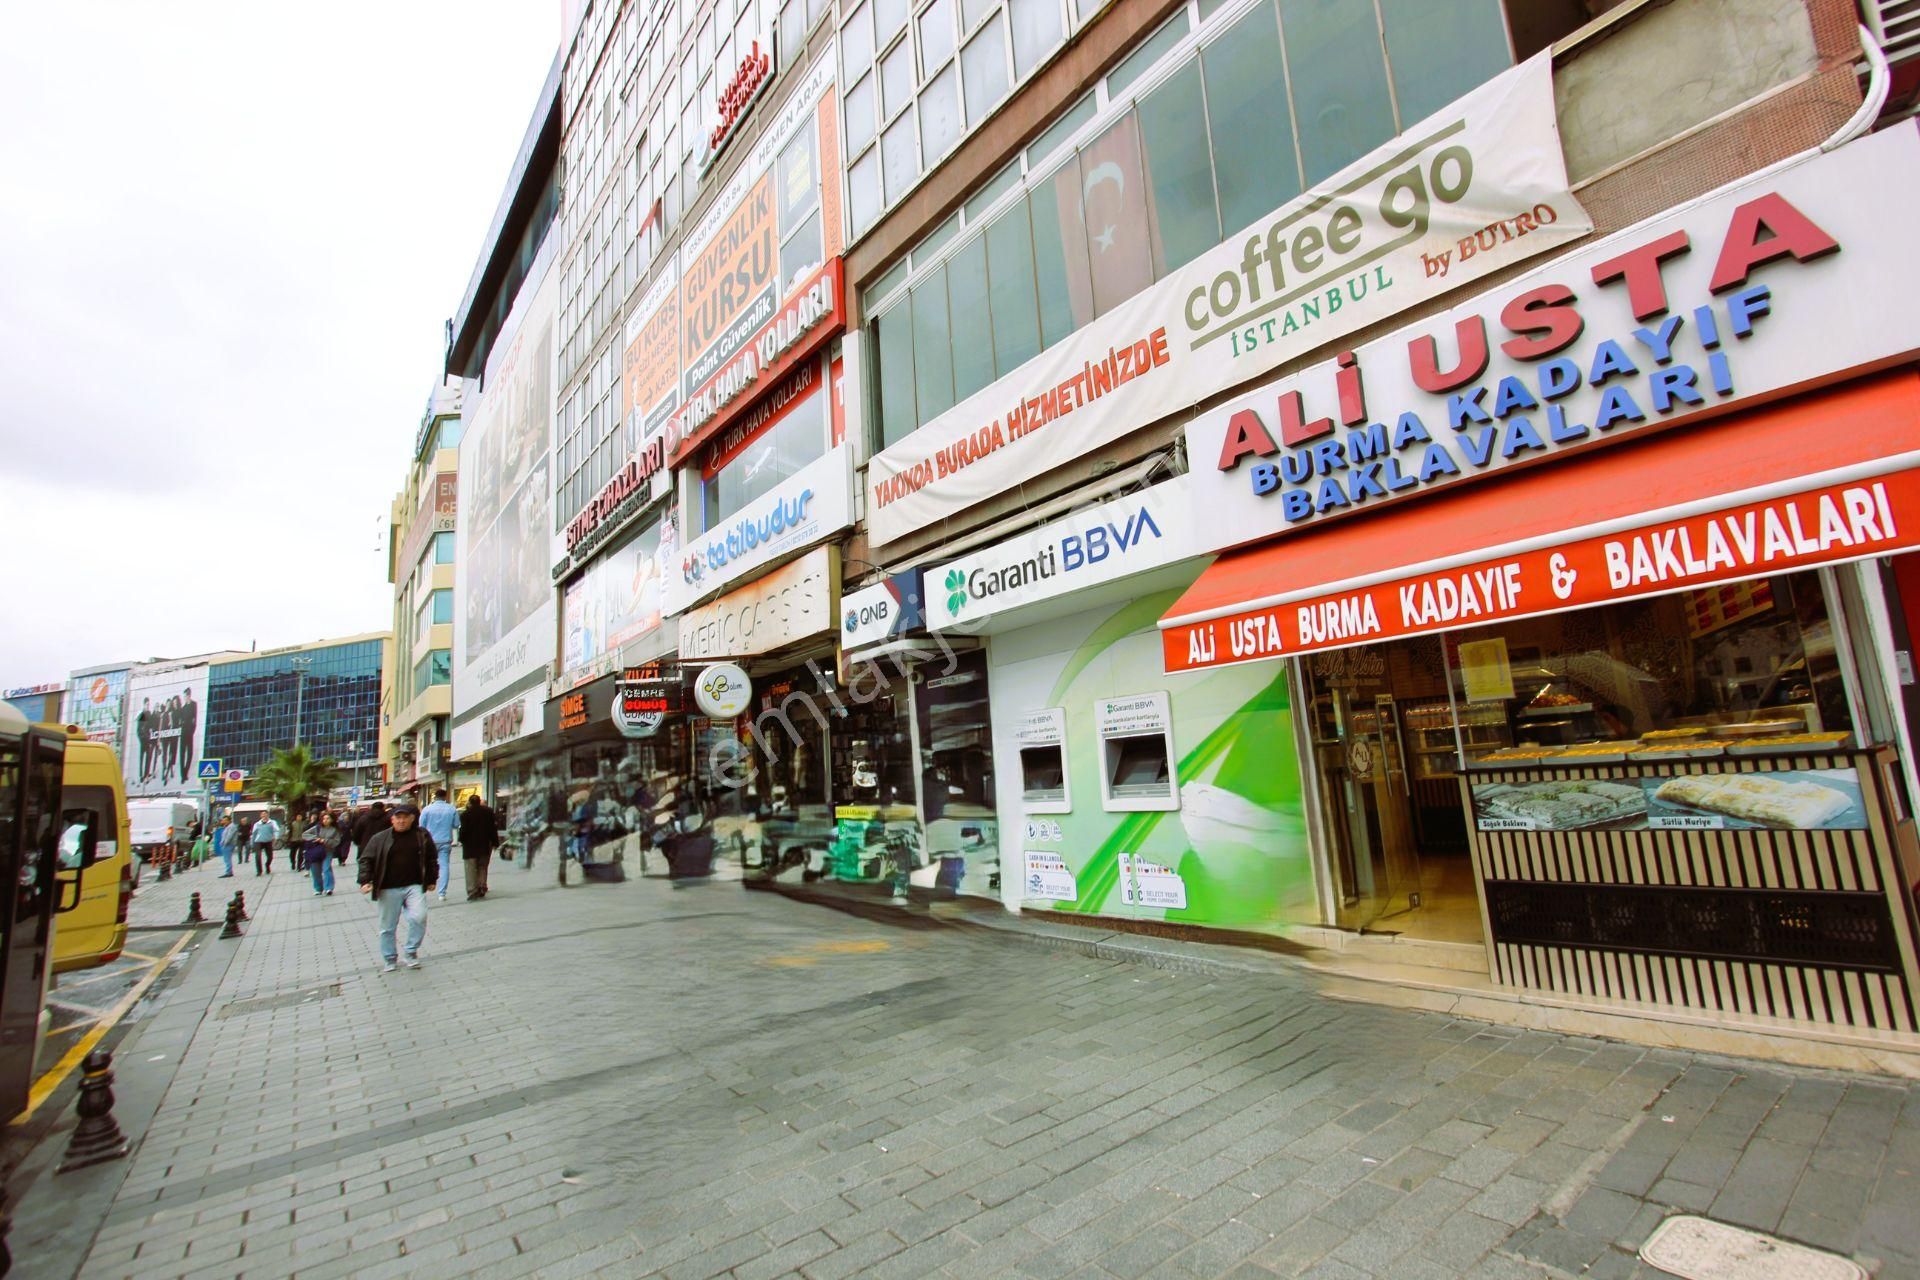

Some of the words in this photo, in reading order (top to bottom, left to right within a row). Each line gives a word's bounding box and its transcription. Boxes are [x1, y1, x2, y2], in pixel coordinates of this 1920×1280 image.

[687, 226, 771, 359] KURSU
[688, 184, 768, 305] GÜVENLİK
[1185, 202, 1363, 332] coffee
[1381, 143, 1474, 246] go
[1231, 265, 1395, 358] İSTANBUL
[1420, 249, 1451, 280] by
[1457, 202, 1558, 266] BUTRO
[1407, 192, 1841, 394] USTA
[644, 296, 676, 347] KURS
[680, 390, 715, 440] TÜRK
[716, 350, 757, 406] HAVA
[756, 275, 833, 370] YOLLARI
[692, 350, 718, 387] Point
[720, 296, 772, 355] Güvenlik
[724, 430, 746, 453] TÜRK
[747, 404, 770, 433] HAVA
[771, 366, 812, 414] YOLLARI
[936, 420, 1005, 479] BURADA
[1006, 326, 1170, 443] HİZMETİNİZDE
[1251, 411, 1432, 497] BURMA
[1449, 284, 1772, 432] KADAYIF
[1282, 351, 1736, 523] BAKLAVALARI
[706, 488, 814, 571] tatilbudur
[968, 545, 1056, 600] Garanti
[1062, 506, 1162, 572] BBVA
[1229, 614, 1282, 657] USTA
[1298, 593, 1381, 645] BURMA
[1400, 563, 1522, 627] KADAYIF
[1549, 552, 1577, 600] &
[1604, 482, 1898, 590] BAKLAVALARI
[860, 600, 888, 626] QNB
[1113, 704, 1134, 712] Garanti
[1135, 701, 1154, 710] BBVA
[1685, 817, 1711, 827] Nuriye
